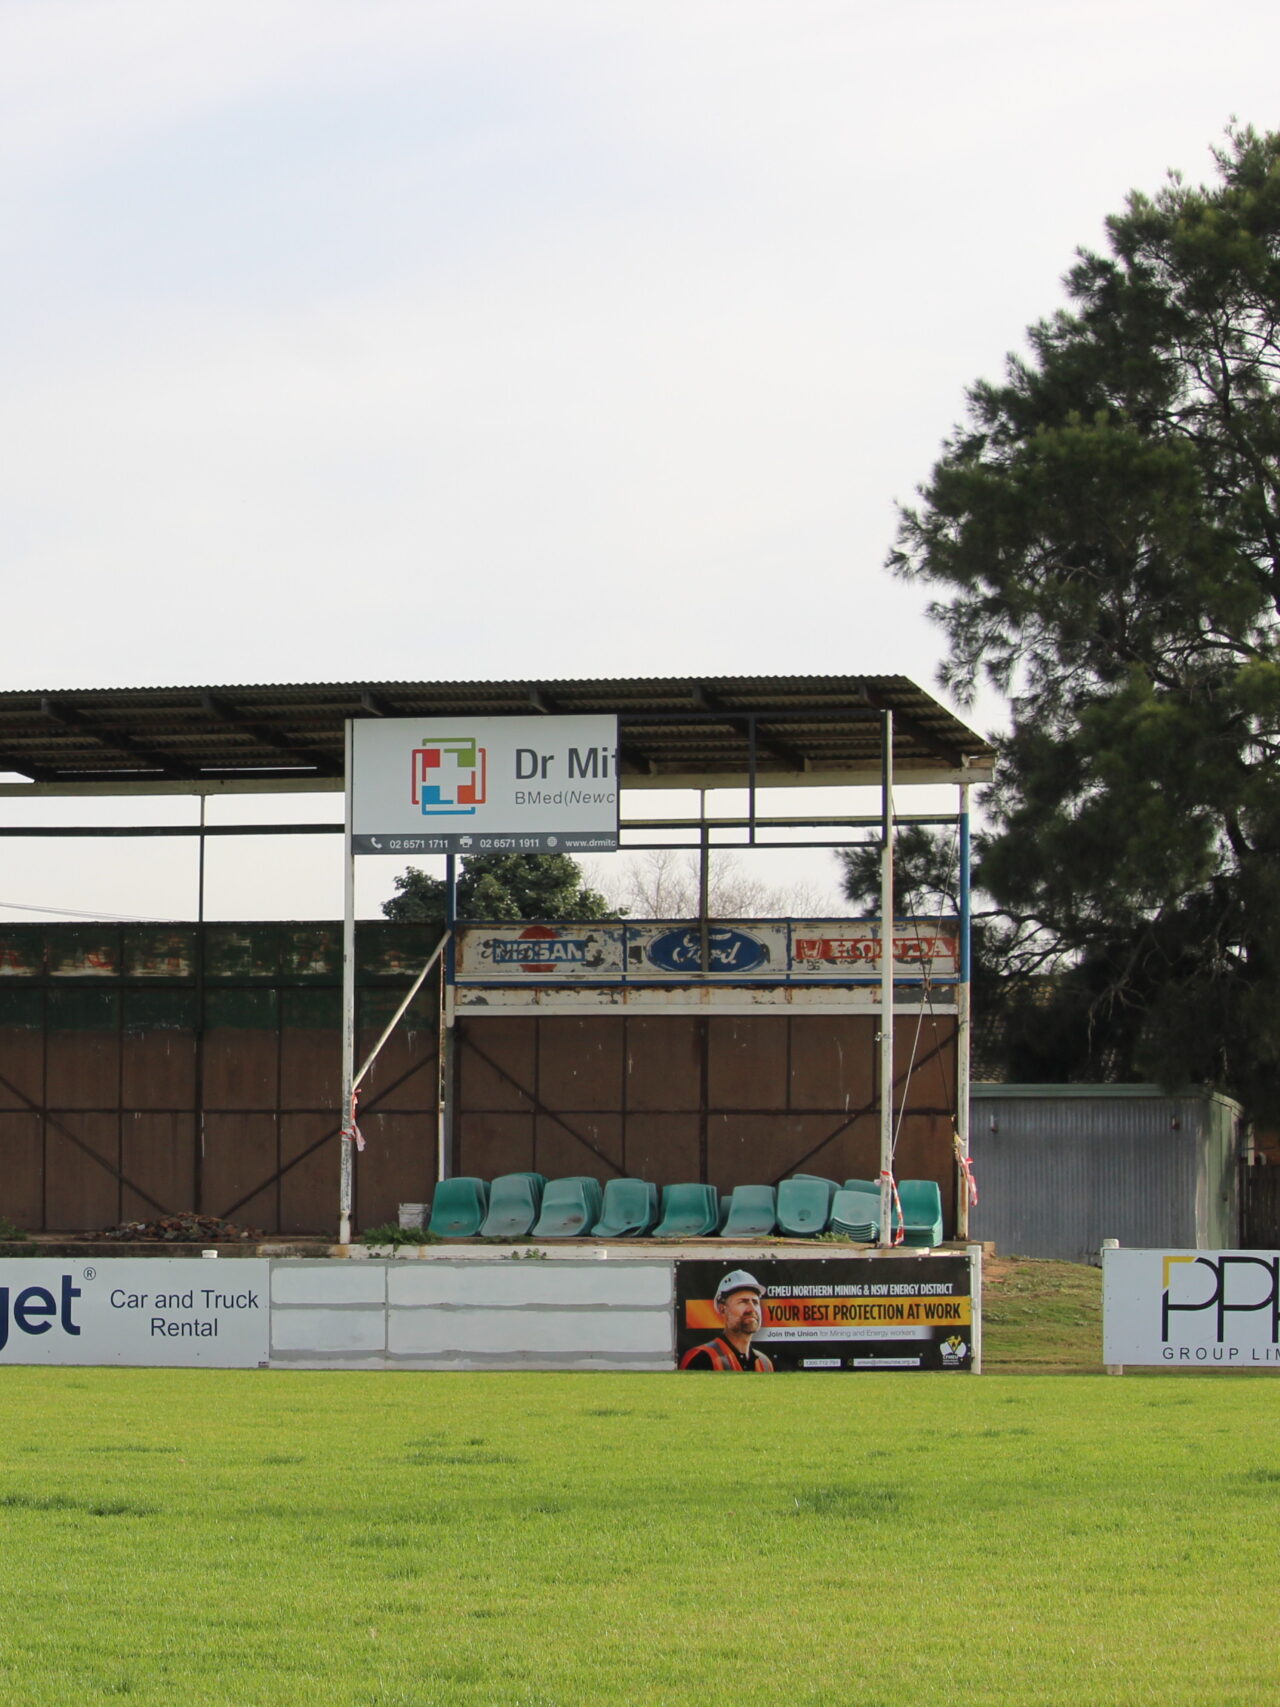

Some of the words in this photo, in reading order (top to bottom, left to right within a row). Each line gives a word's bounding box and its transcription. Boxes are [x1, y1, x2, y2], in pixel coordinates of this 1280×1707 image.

[516, 748, 554, 779] Dr
[390, 840, 400, 848] 02
[404, 840, 424, 848] 6571
[428, 840, 448, 848] 1711
[480, 840, 492, 848] 02
[494, 840, 516, 848] 6571
[520, 839, 539, 848] 1911
[495, 943, 582, 960] NISSAN
[672, 932, 742, 964] Ford
[110, 1289, 148, 1308] Car
[154, 1290, 194, 1308] and
[200, 1290, 259, 1308] Truck
[767, 1286, 792, 1296] CFMEU
[792, 1285, 833, 1296] NORTHERN
[834, 1284, 862, 1296] MINING
[863, 1284, 870, 1295] &
[870, 1284, 888, 1294] NSW
[890, 1284, 919, 1294] ENERGY
[920, 1284, 953, 1294] DISTRICT
[768, 1305, 800, 1321] YOUR
[802, 1305, 830, 1320] BEST
[833, 1304, 904, 1320] PROTECTION
[907, 1304, 920, 1319] AT
[924, 1303, 961, 1318] WORK
[150, 1318, 218, 1337] Rental
[768, 1330, 783, 1338] Join
[784, 1330, 796, 1338] the
[1162, 1347, 1239, 1360] GROUP
